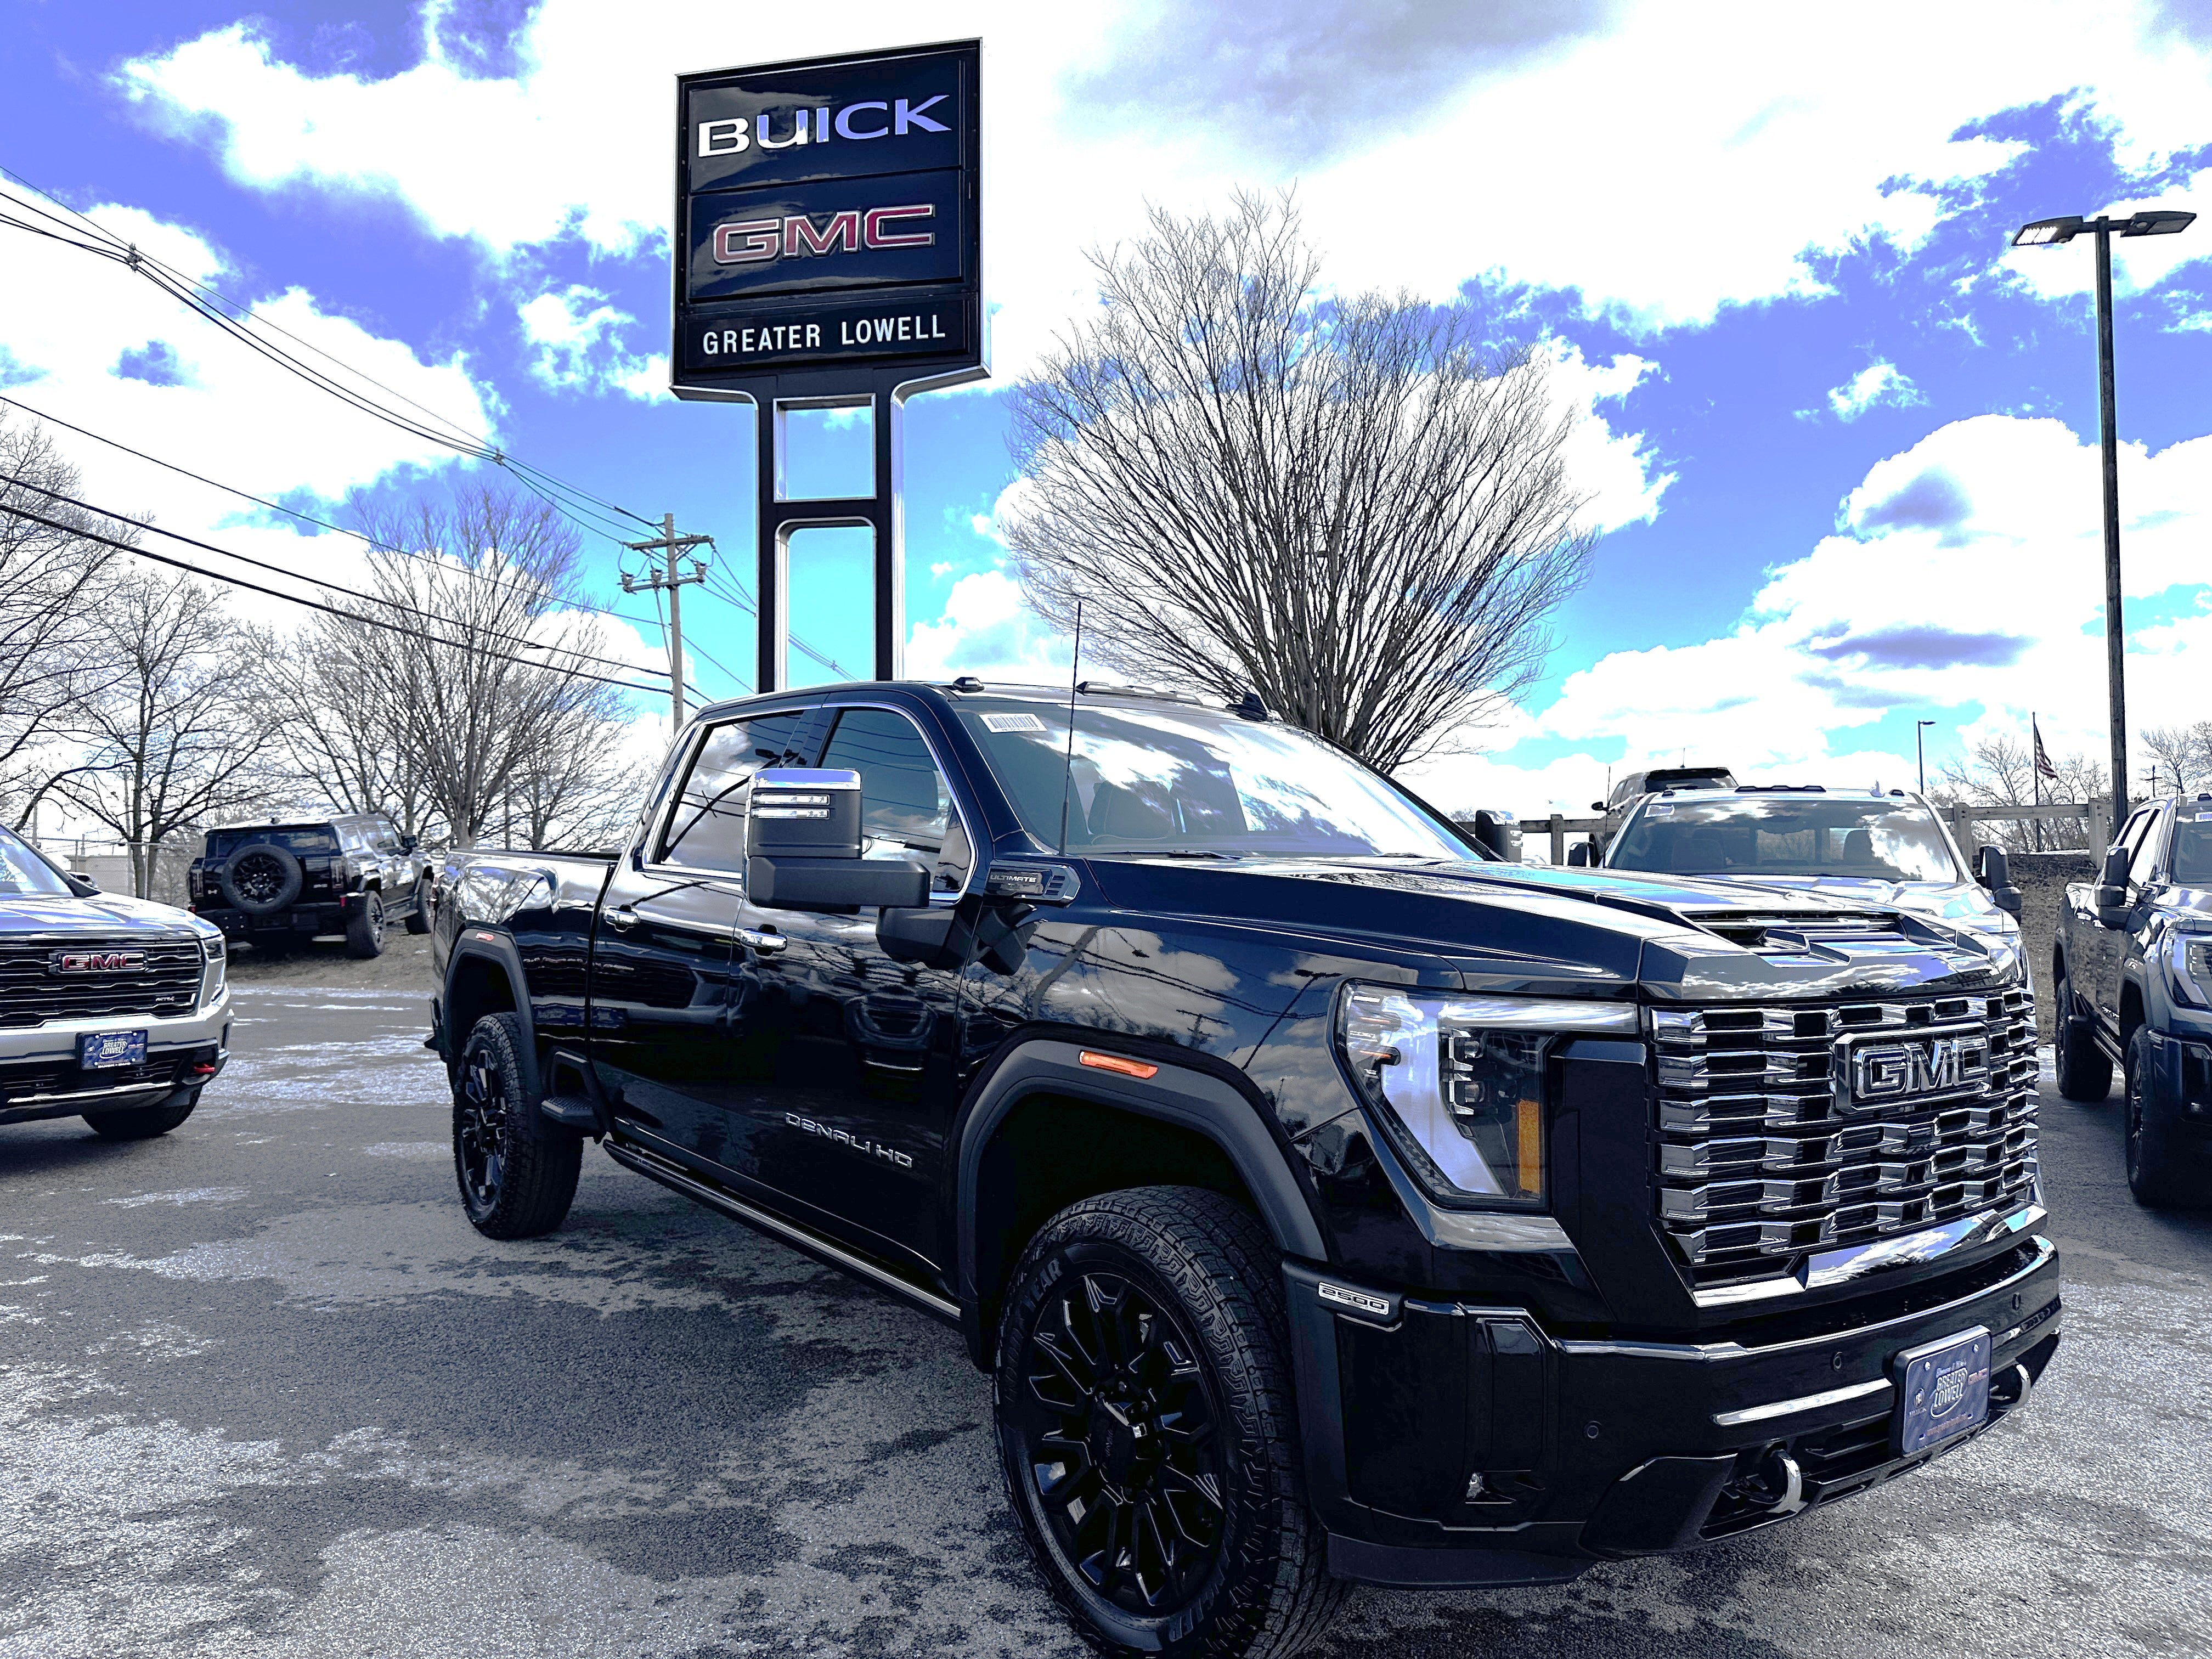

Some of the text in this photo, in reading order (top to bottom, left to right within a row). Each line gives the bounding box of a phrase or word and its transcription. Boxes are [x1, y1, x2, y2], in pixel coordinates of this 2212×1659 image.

[698, 94, 952, 157] BUICK
[713, 204, 934, 265] GMC
[703, 314, 946, 356] GREATER LOWELL
[990, 874, 1037, 883] ULTIMATE
[62, 953, 144, 970] GMC
[102, 1046, 125, 1054] LOWELL
[1856, 1036, 1988, 1098] GMC
[785, 1112, 912, 1169] DENALI HD
[1322, 1286, 1385, 1310] 2500
[1937, 1368, 1966, 1391] GREATER
[1933, 1383, 1963, 1408] LOWELL
